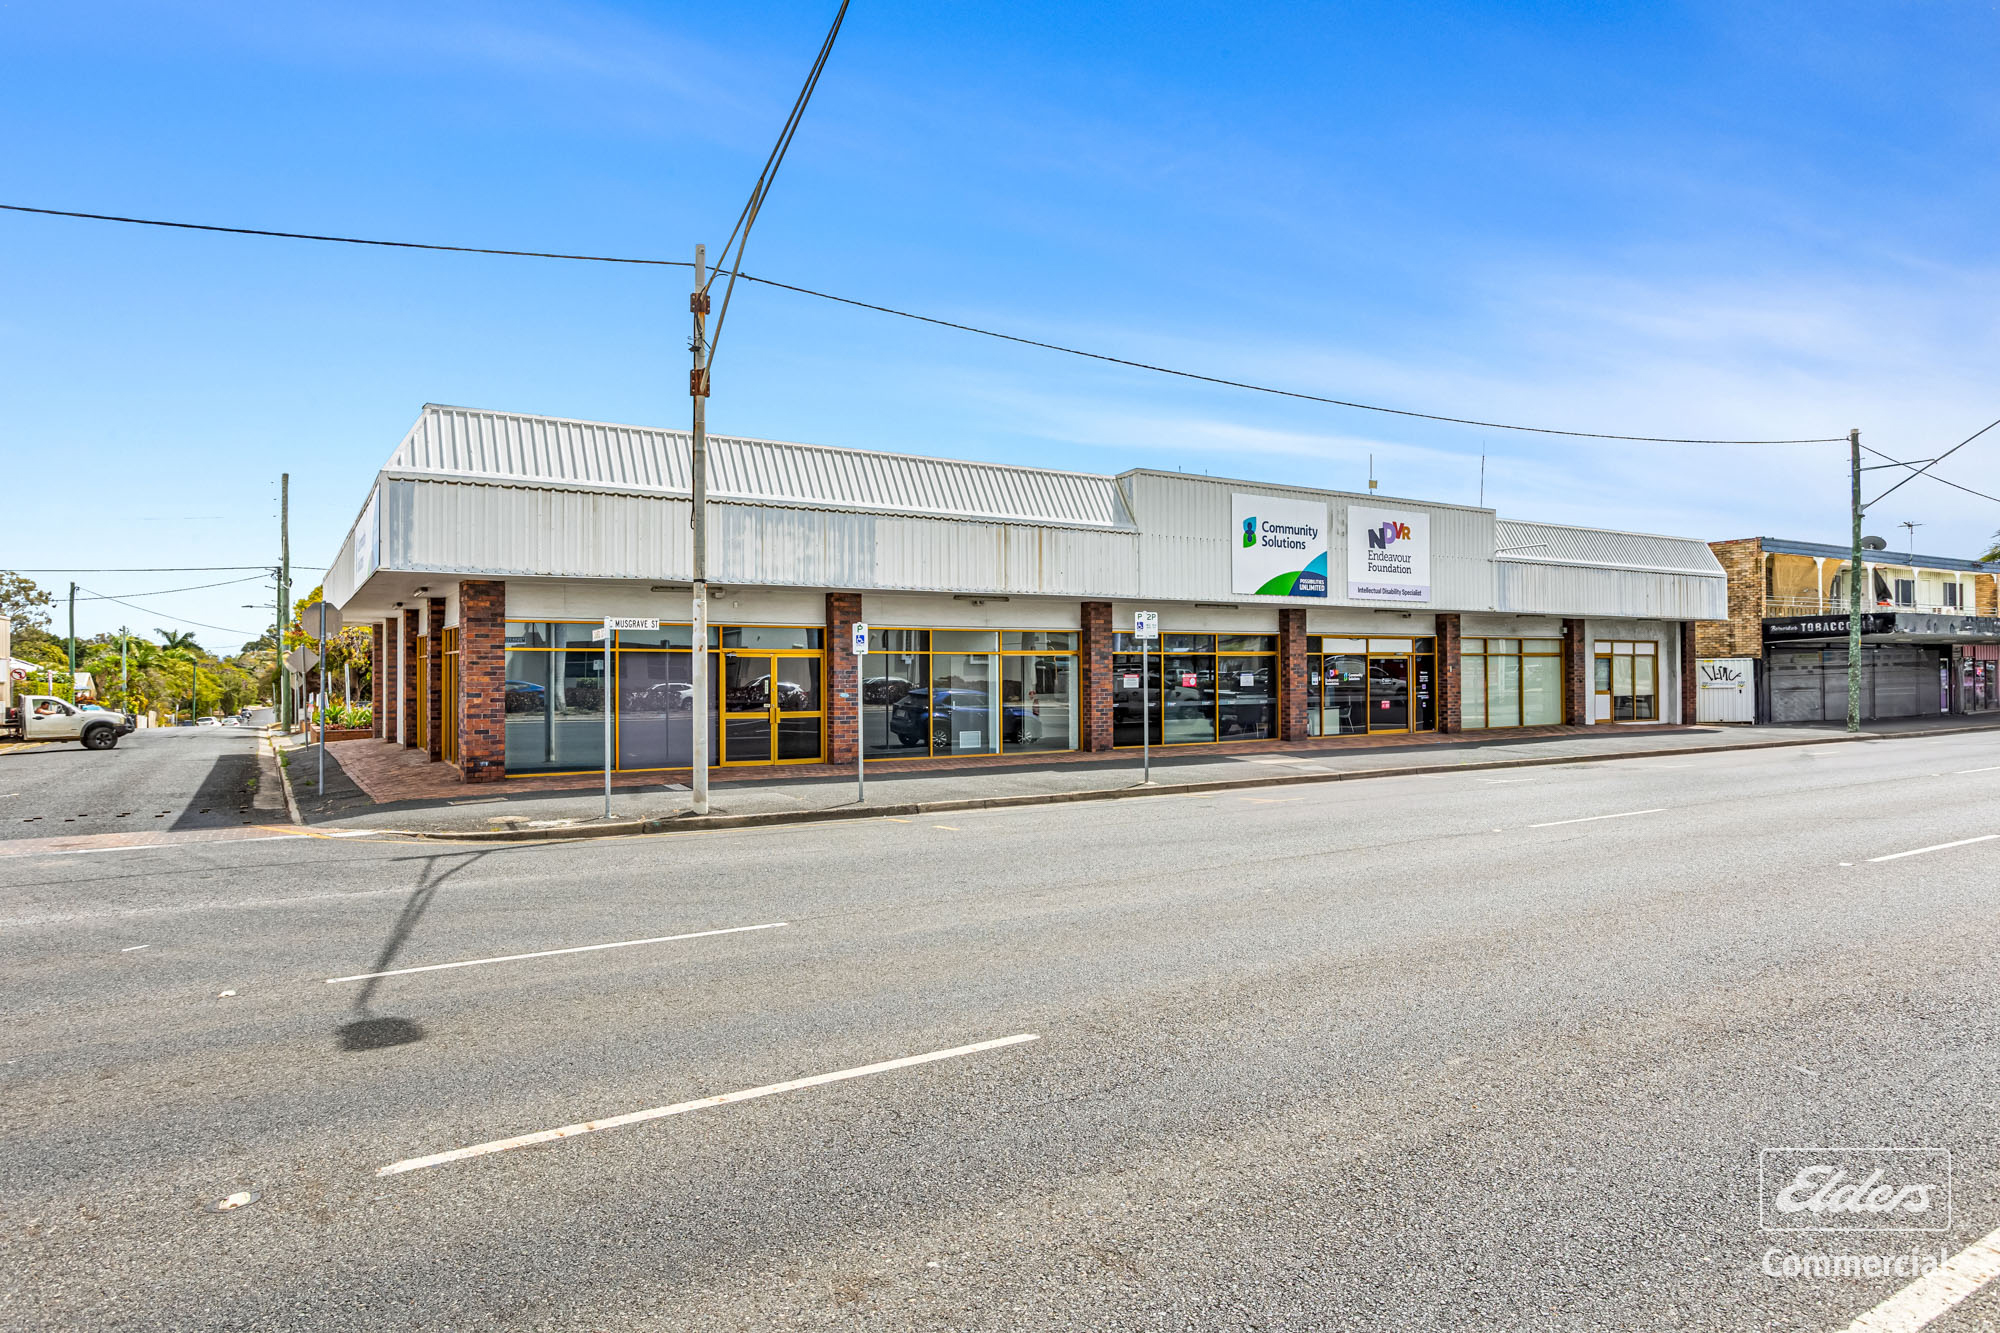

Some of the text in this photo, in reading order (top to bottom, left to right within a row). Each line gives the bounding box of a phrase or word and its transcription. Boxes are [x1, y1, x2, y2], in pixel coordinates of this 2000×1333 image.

[1261, 521, 1318, 540] Community
[1367, 521, 1411, 549] NDVR
[1261, 535, 1306, 550] Solutions
[1368, 550, 1412, 563] Endeavour
[1368, 562, 1412, 574] Foundation
[1299, 584, 1325, 592] UNLIMITED
[1357, 586, 1381, 594] Intellectual
[1382, 588, 1401, 596] Disability
[615, 619, 648, 628] MUSGRAVE
[651, 620, 658, 628] ST
